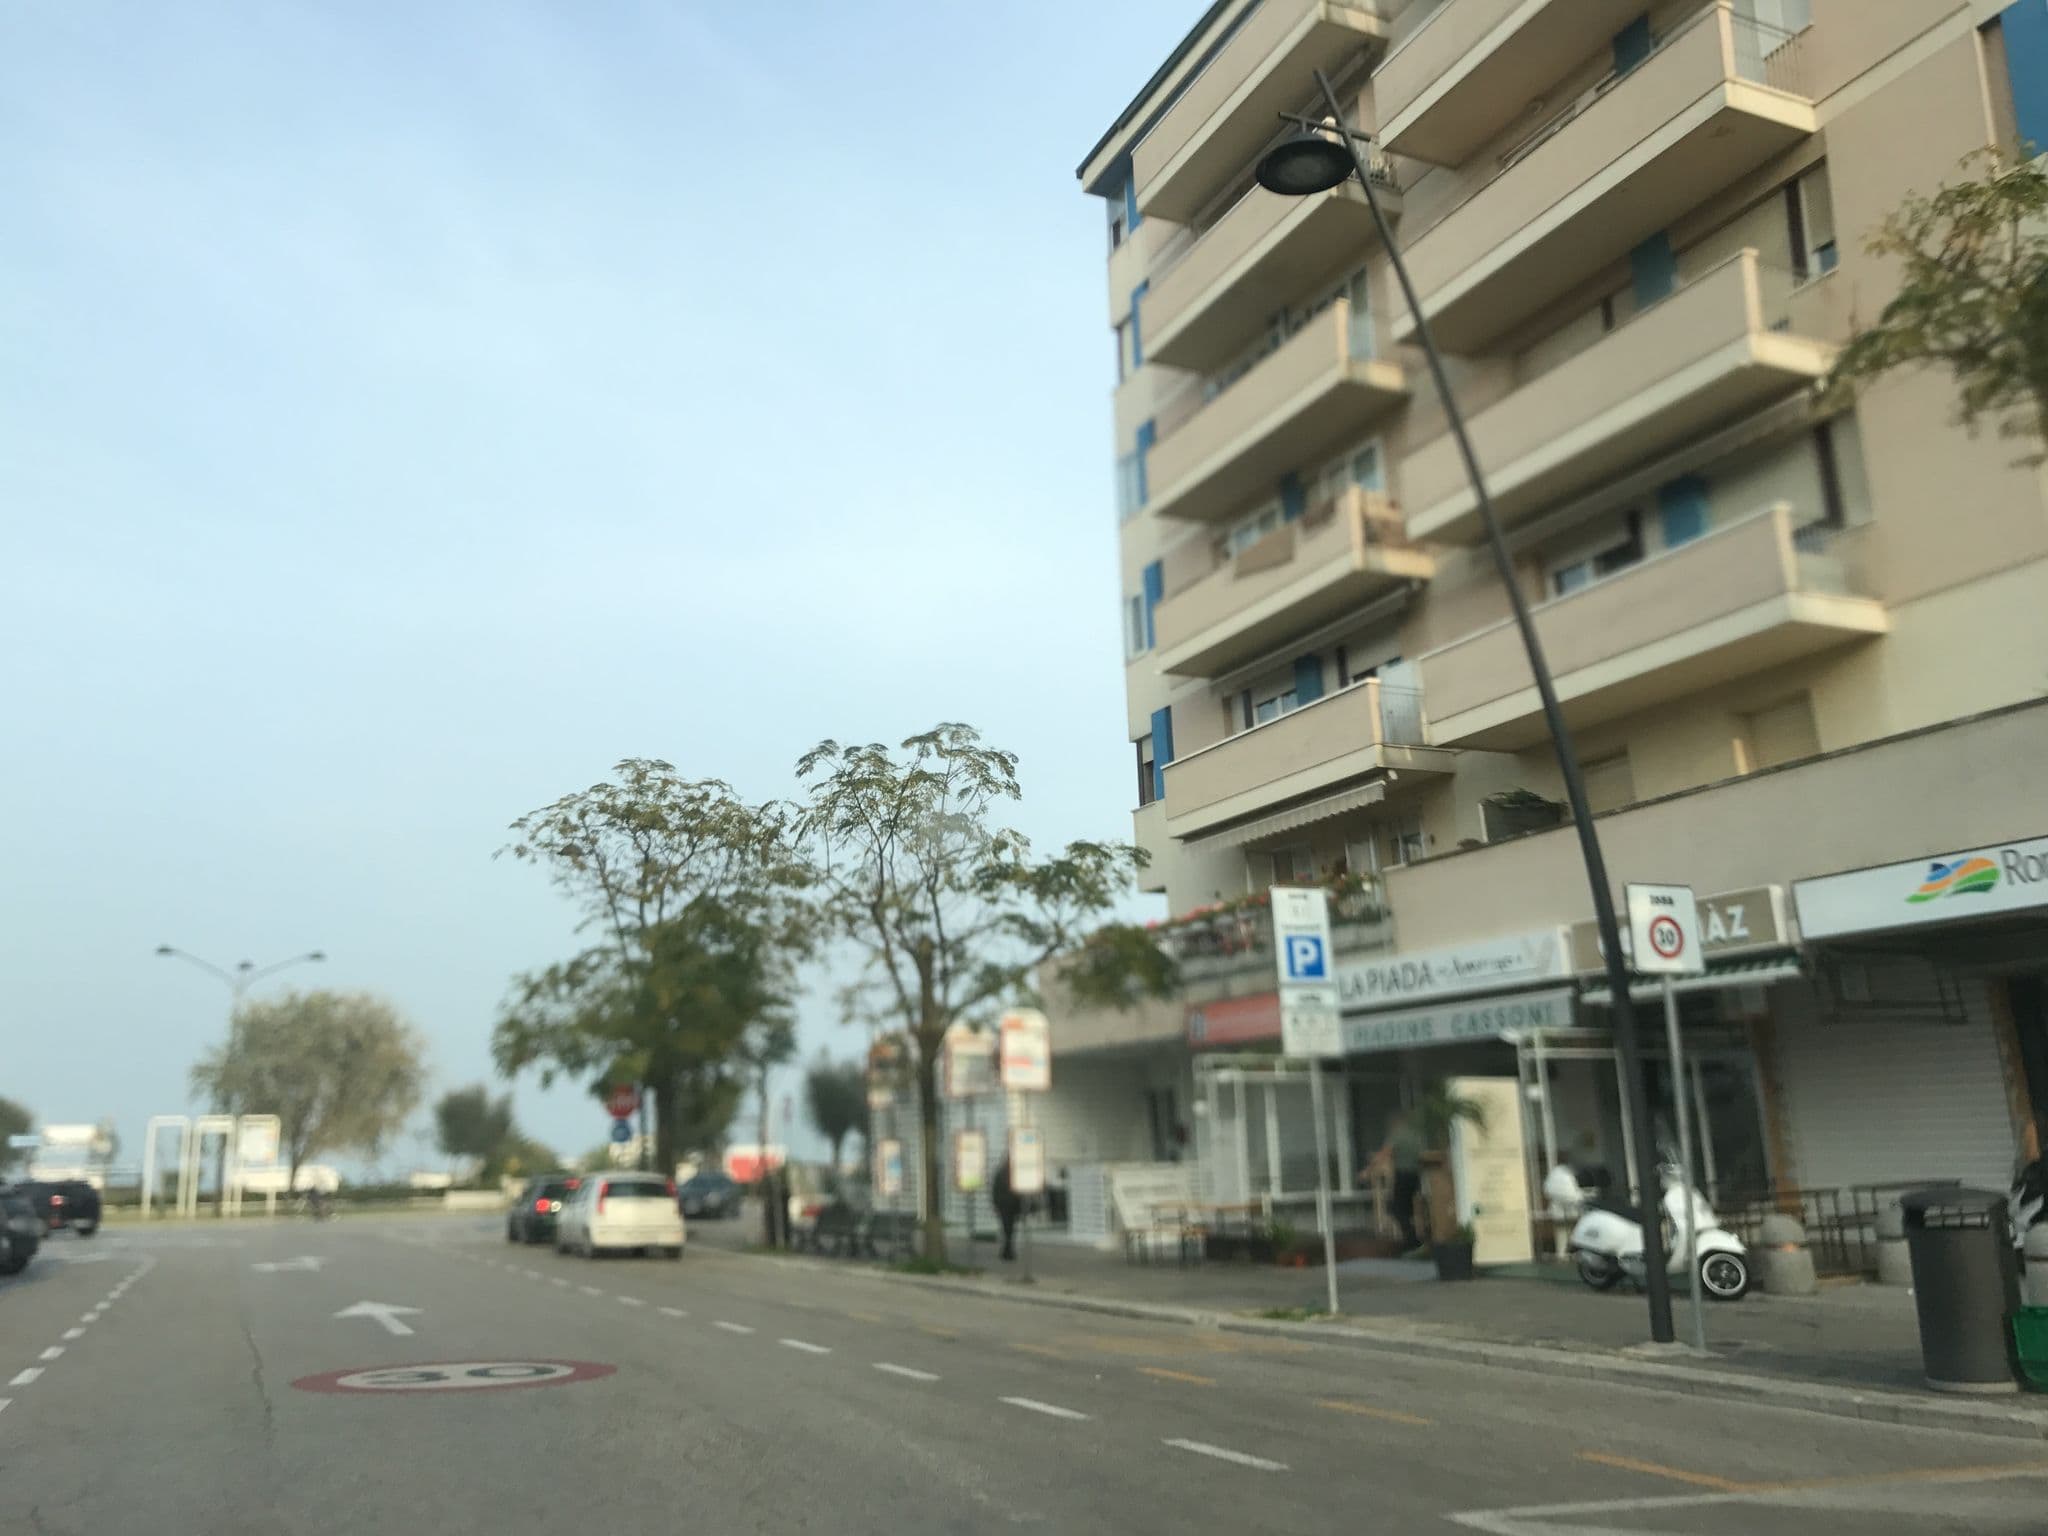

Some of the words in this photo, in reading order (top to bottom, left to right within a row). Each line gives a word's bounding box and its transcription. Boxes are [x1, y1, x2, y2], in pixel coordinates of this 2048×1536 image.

[2001, 849, 2048, 885] Ro
[1658, 928, 1675, 946] 30
[1292, 939, 1318, 974] P
[360, 1364, 557, 1385] 30
